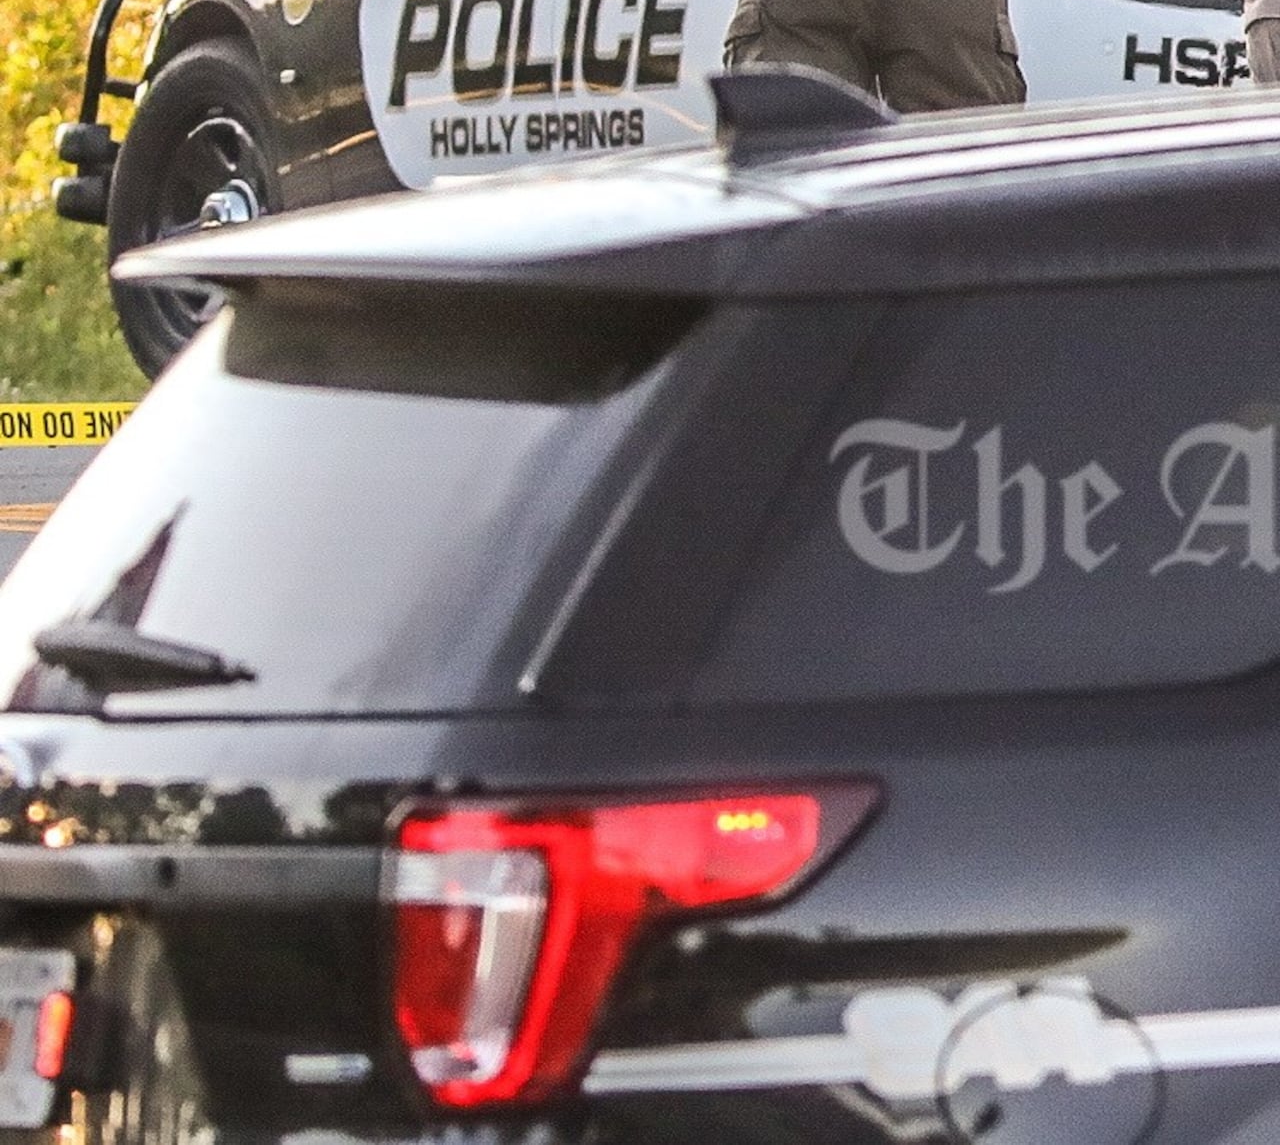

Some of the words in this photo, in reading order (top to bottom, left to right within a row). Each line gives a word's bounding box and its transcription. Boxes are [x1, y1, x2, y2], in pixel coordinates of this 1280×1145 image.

[429, 113, 519, 159] HOLLY
[525, 108, 646, 154] SPRINGS
[0, 411, 34, 439] NO
[42, 411, 75, 439] DO
